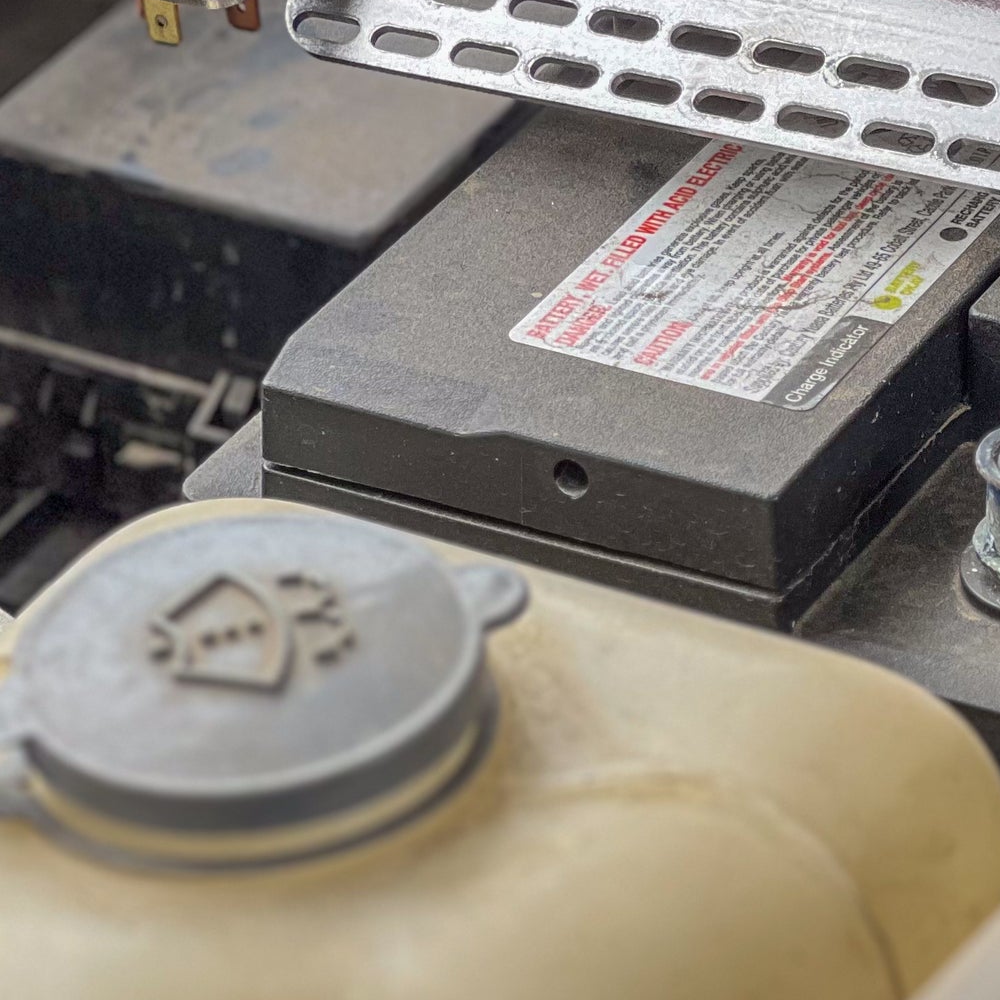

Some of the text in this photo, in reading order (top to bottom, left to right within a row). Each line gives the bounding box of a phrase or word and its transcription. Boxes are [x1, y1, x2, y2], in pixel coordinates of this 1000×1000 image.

[603, 235, 646, 265] FILLED
[636, 209, 673, 233] WITH
[663, 186, 697, 210] ACID
[687, 143, 742, 186] ELECTRIC
[703, 221, 729, 240] battery
[725, 200, 751, 221] contains
[743, 195, 770, 217] accident
[965, 197, 1000, 227] BATTERY
[740, 274, 765, 295] product
[764, 242, 796, 268] warranted
[793, 223, 816, 242] against
[771, 253, 800, 278] purchase
[805, 227, 827, 245] private
[799, 316, 829, 333] Yuasa
[817, 290, 854, 316] Batteries
[862, 251, 892, 270] 49-65
[880, 233, 909, 252] Cobalt
[785, 324, 867, 402] Charge Indicator
